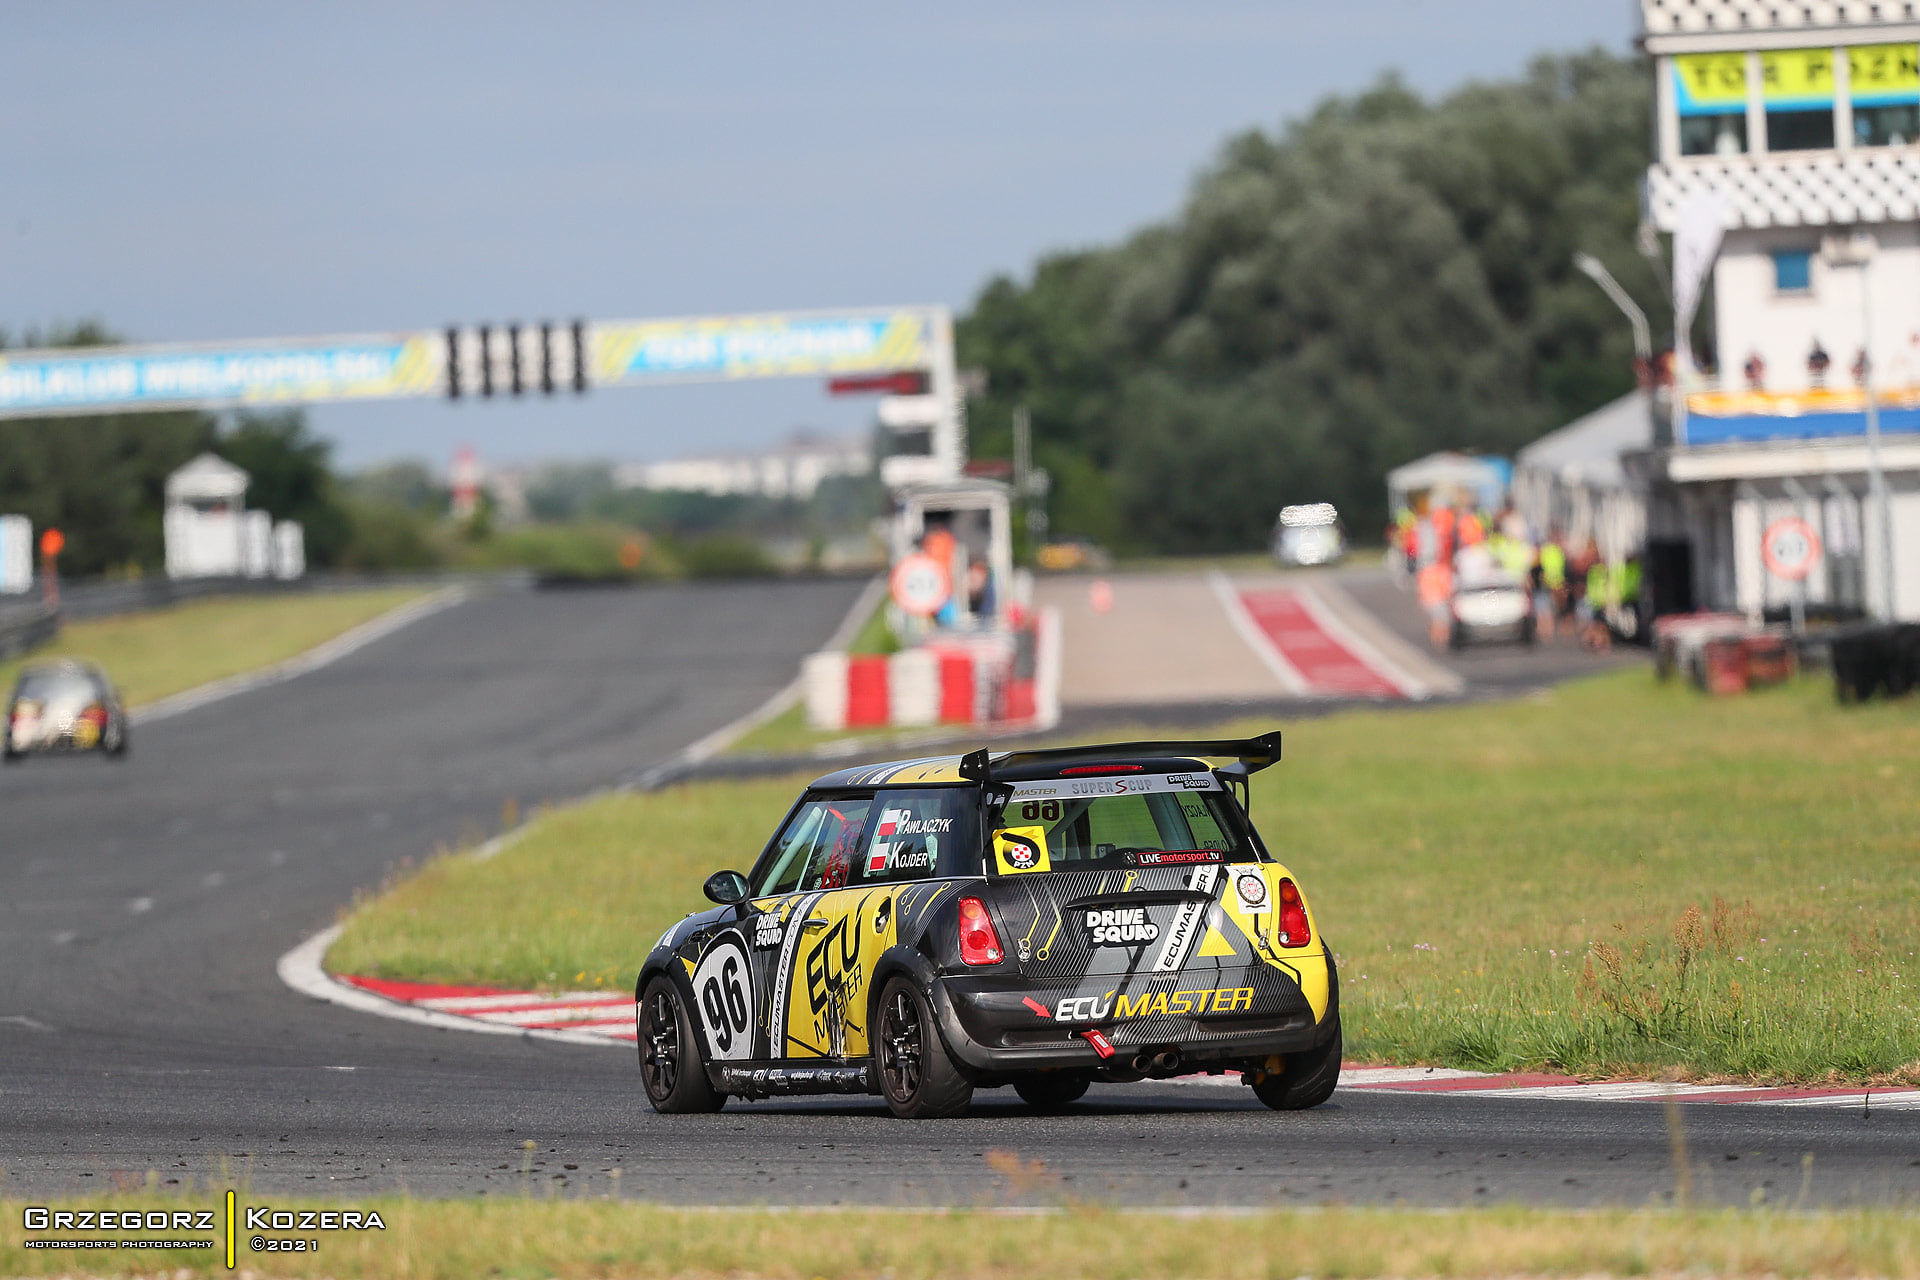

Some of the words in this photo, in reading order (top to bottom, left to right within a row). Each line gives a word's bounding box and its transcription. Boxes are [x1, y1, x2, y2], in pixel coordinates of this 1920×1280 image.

[1168, 775, 1192, 783] DRIVE
[1185, 780, 1210, 788] SQUAD
[1013, 860, 1035, 869] PZM
[1139, 851, 1220, 864] LIVEmotorsport.tv
[755, 912, 781, 930] DRIVE
[1086, 908, 1145, 927] DRIVE
[755, 928, 783, 946] SQUAD
[1092, 922, 1160, 943] SQUAD
[702, 955, 748, 1053] 96
[1114, 987, 1254, 1018] MASTER
